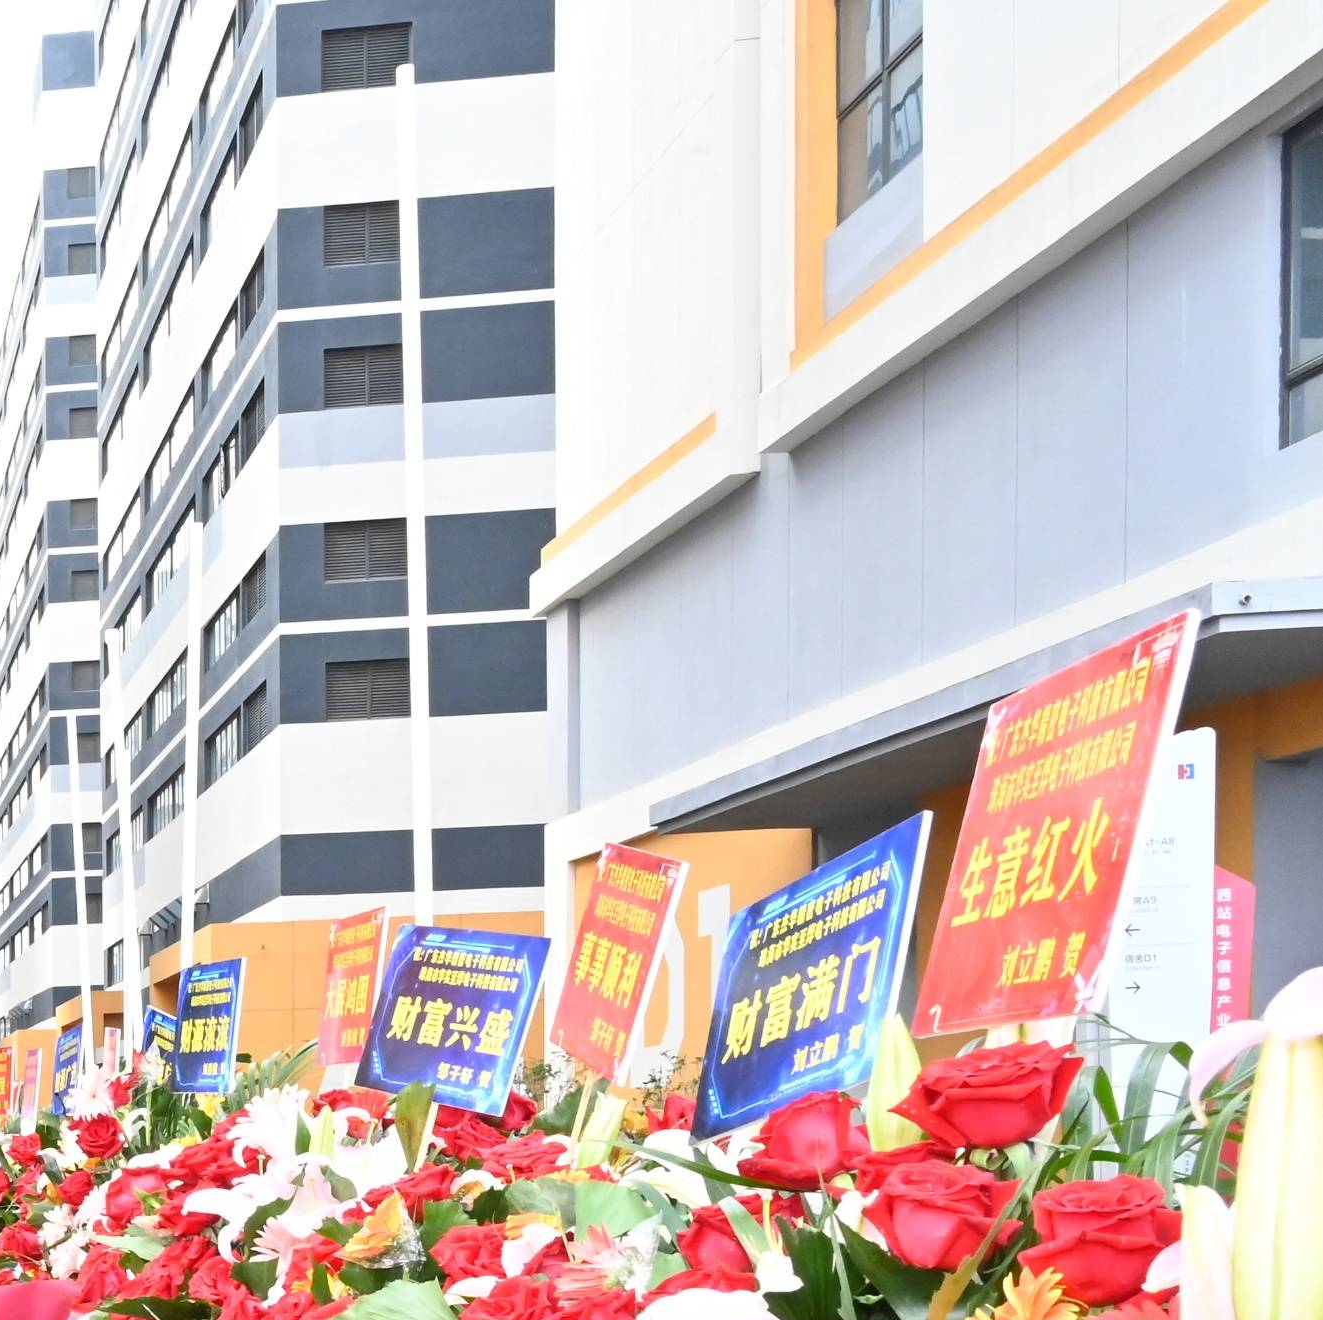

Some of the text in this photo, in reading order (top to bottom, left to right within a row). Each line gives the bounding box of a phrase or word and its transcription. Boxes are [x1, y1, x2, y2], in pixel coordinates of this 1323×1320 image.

[951, 797, 1109, 928] 生意红火
[1146, 837, 1175, 847] 1-A8
[574, 931, 643, 1009] 事事顺利
[1059, 932, 1086, 979] 贺
[325, 974, 370, 1019] 大展鸿图
[386, 995, 514, 1056] 财富兴盛
[721, 936, 881, 1064] 财富满门
